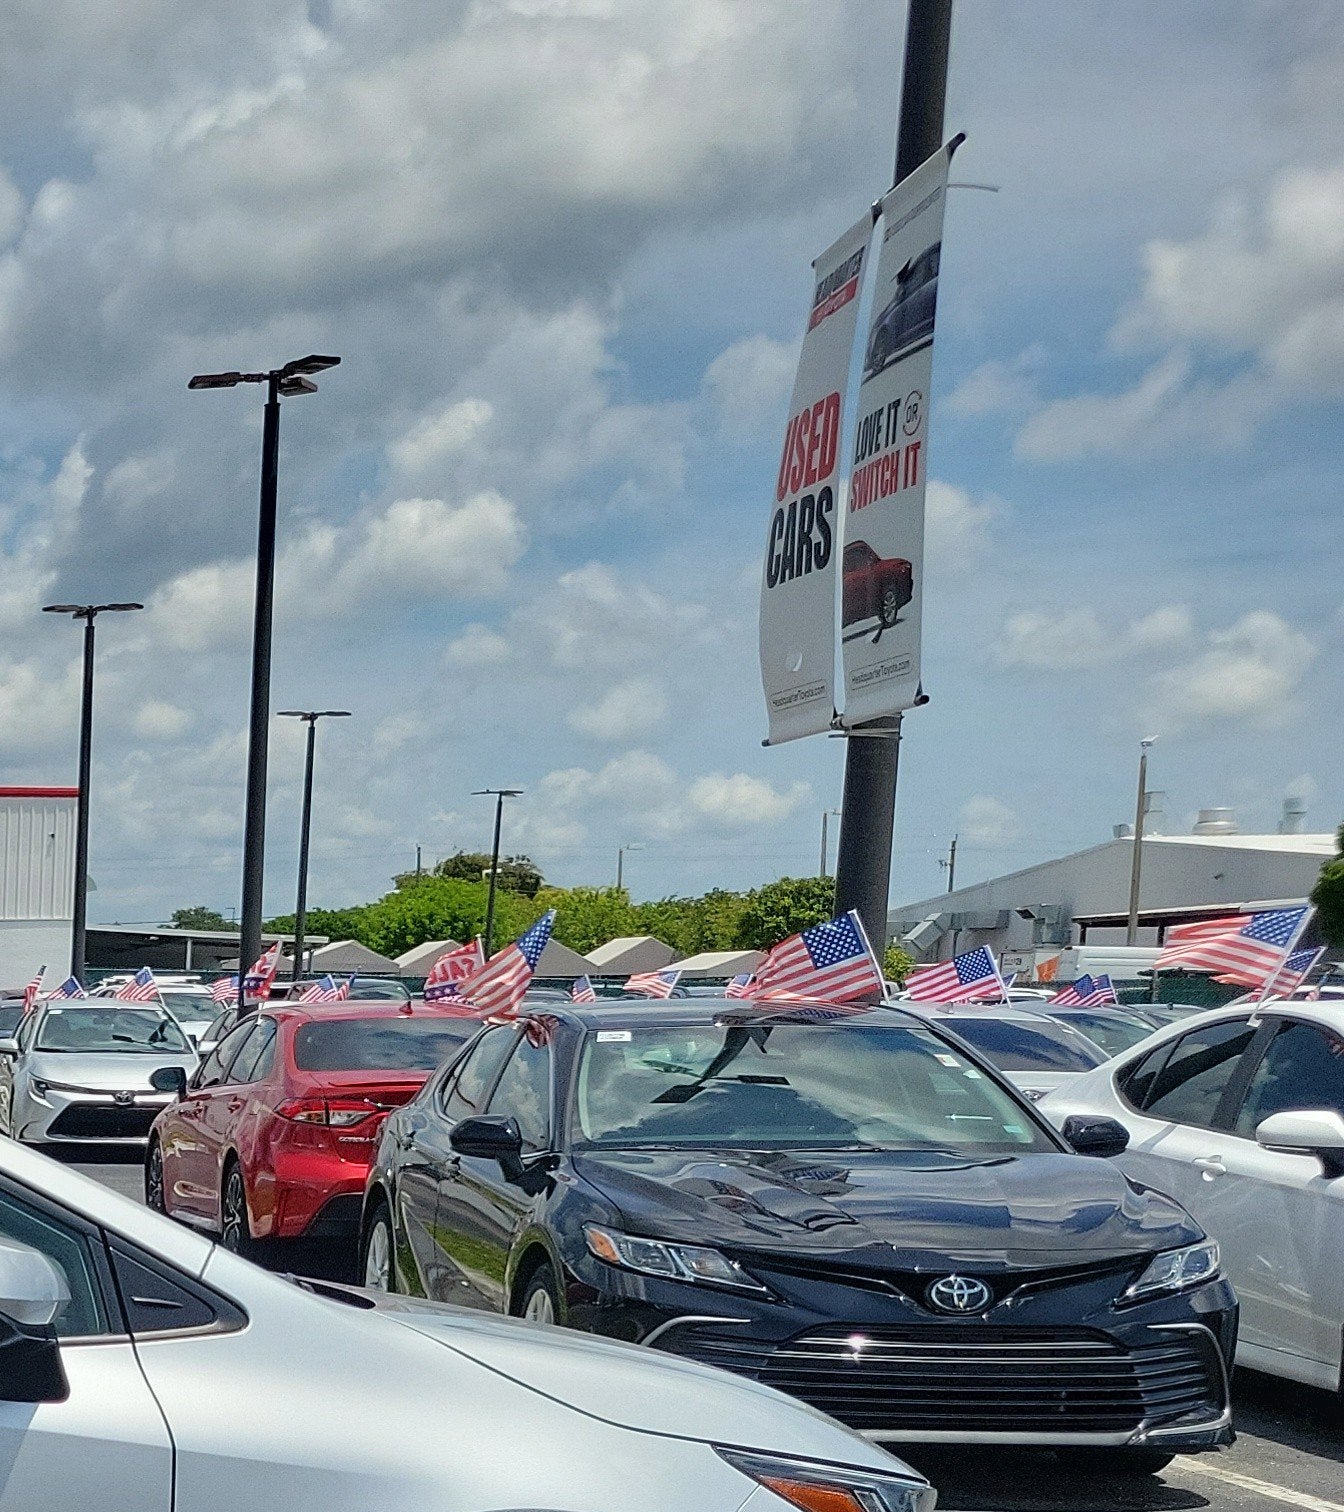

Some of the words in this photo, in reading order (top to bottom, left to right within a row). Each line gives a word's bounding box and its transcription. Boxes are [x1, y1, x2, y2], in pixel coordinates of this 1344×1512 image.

[777, 391, 840, 502] USED
[854, 407, 884, 465] LOVE
[884, 398, 901, 448] IT
[906, 402, 919, 423] OR
[850, 449, 900, 513] SWITCH
[902, 441, 921, 490] IT
[766, 486, 833, 589] CARS
